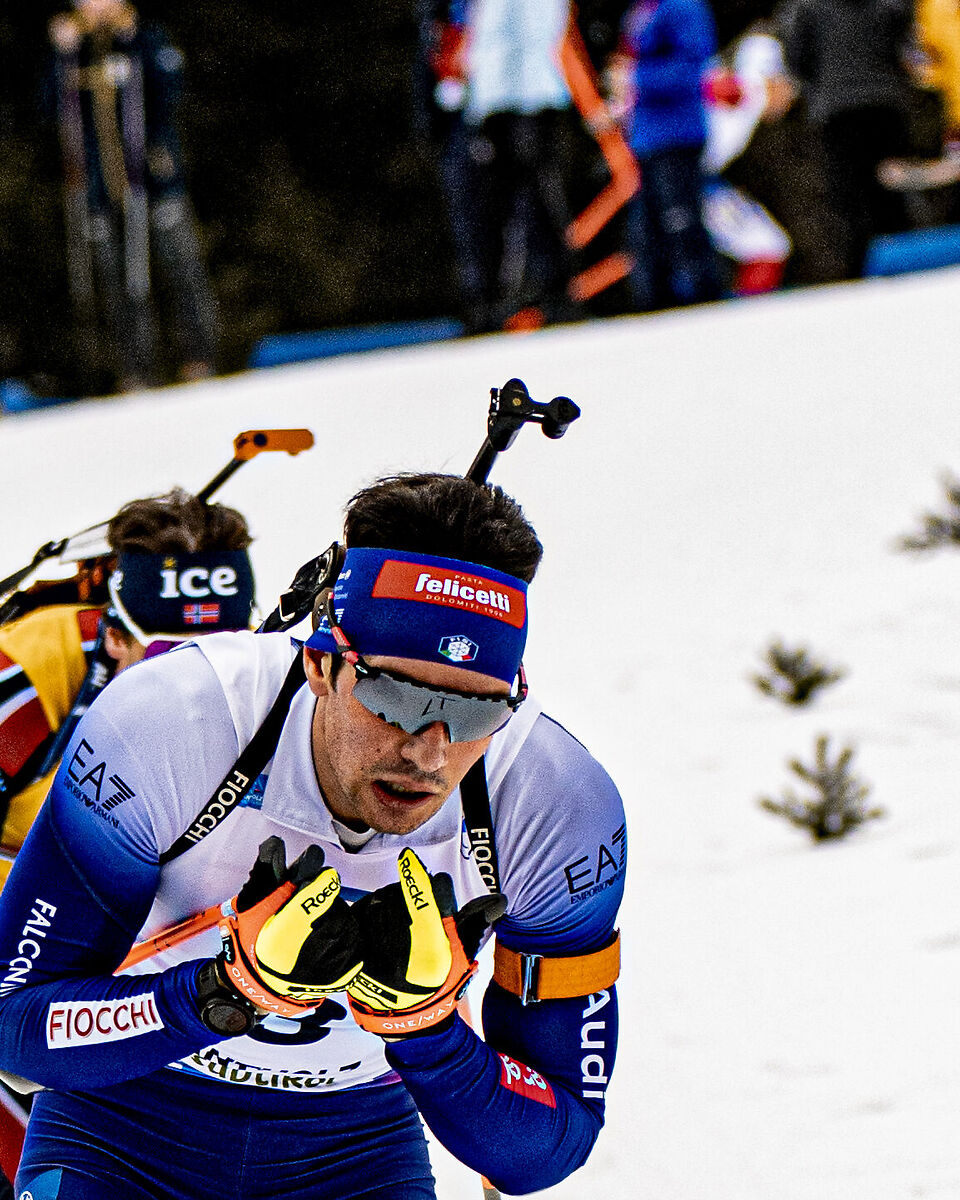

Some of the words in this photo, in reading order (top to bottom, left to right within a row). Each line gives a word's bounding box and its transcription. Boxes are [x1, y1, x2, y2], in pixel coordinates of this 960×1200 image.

[159, 556, 240, 599] ice
[414, 572, 511, 614] felicetti
[425, 594, 480, 610] DOLOMITI
[184, 770, 250, 843] FIOCCHI
[49, 999, 159, 1041] FIOCCHI
[580, 988, 611, 1099] Audi
